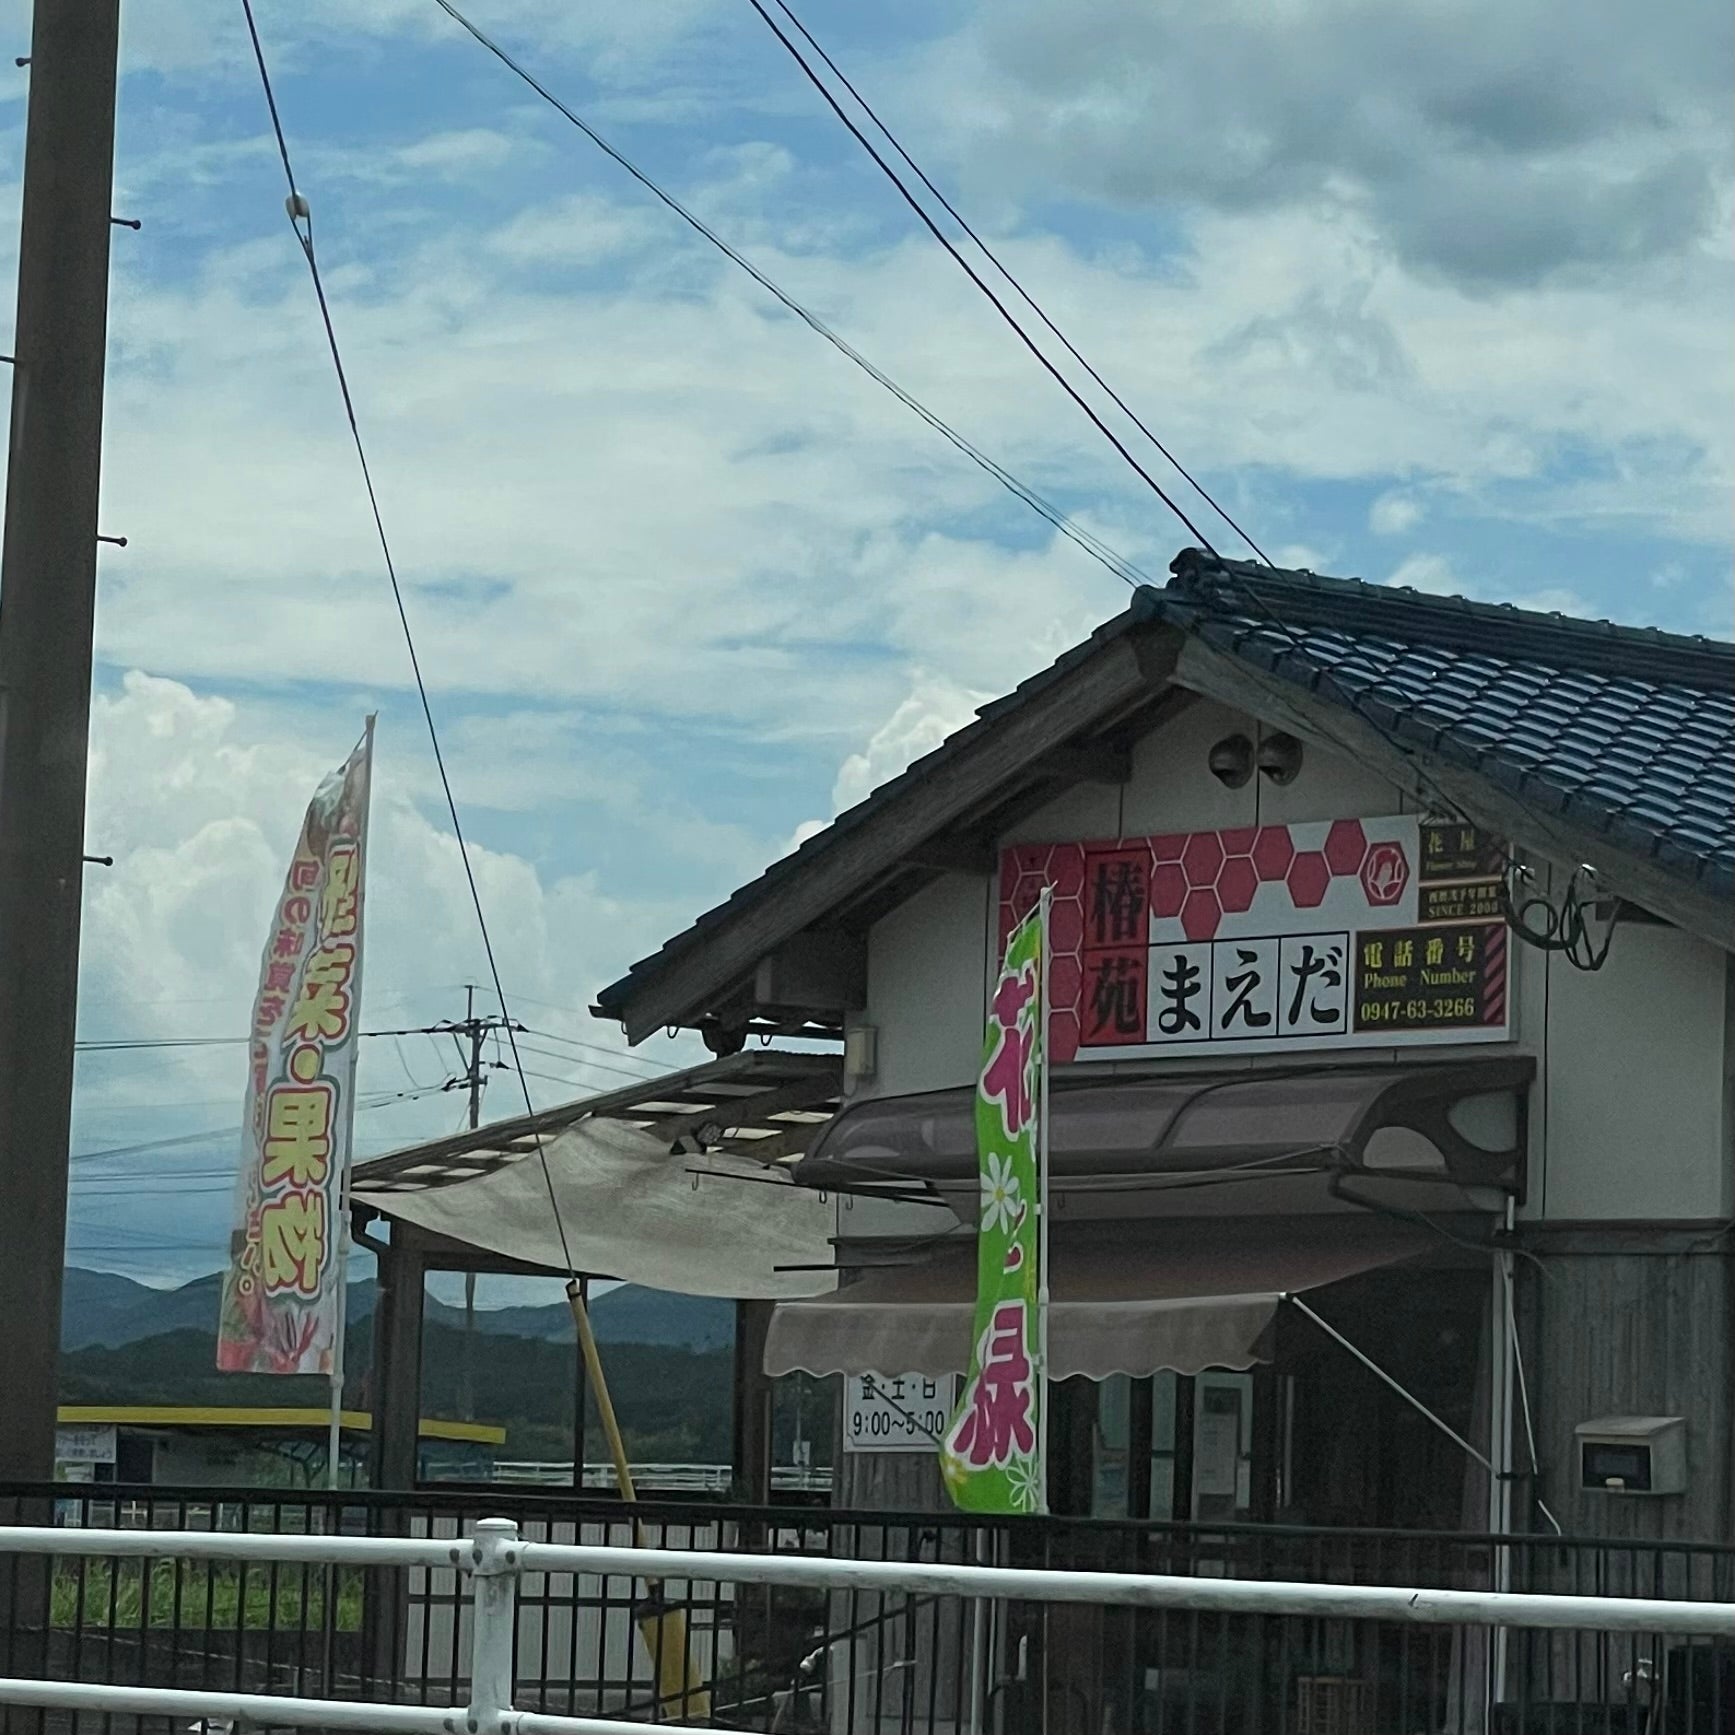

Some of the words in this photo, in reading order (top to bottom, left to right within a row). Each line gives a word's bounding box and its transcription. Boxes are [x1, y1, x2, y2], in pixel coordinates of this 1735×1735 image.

[1428, 904, 1464, 918] SINCE
[1363, 936, 1475, 968] 電話番号
[1159, 945, 1343, 1034] まえだ
[1364, 972, 1407, 989] Phone
[1420, 968, 1476, 985] Number
[1361, 998, 1475, 1021] 0947-63-3266
